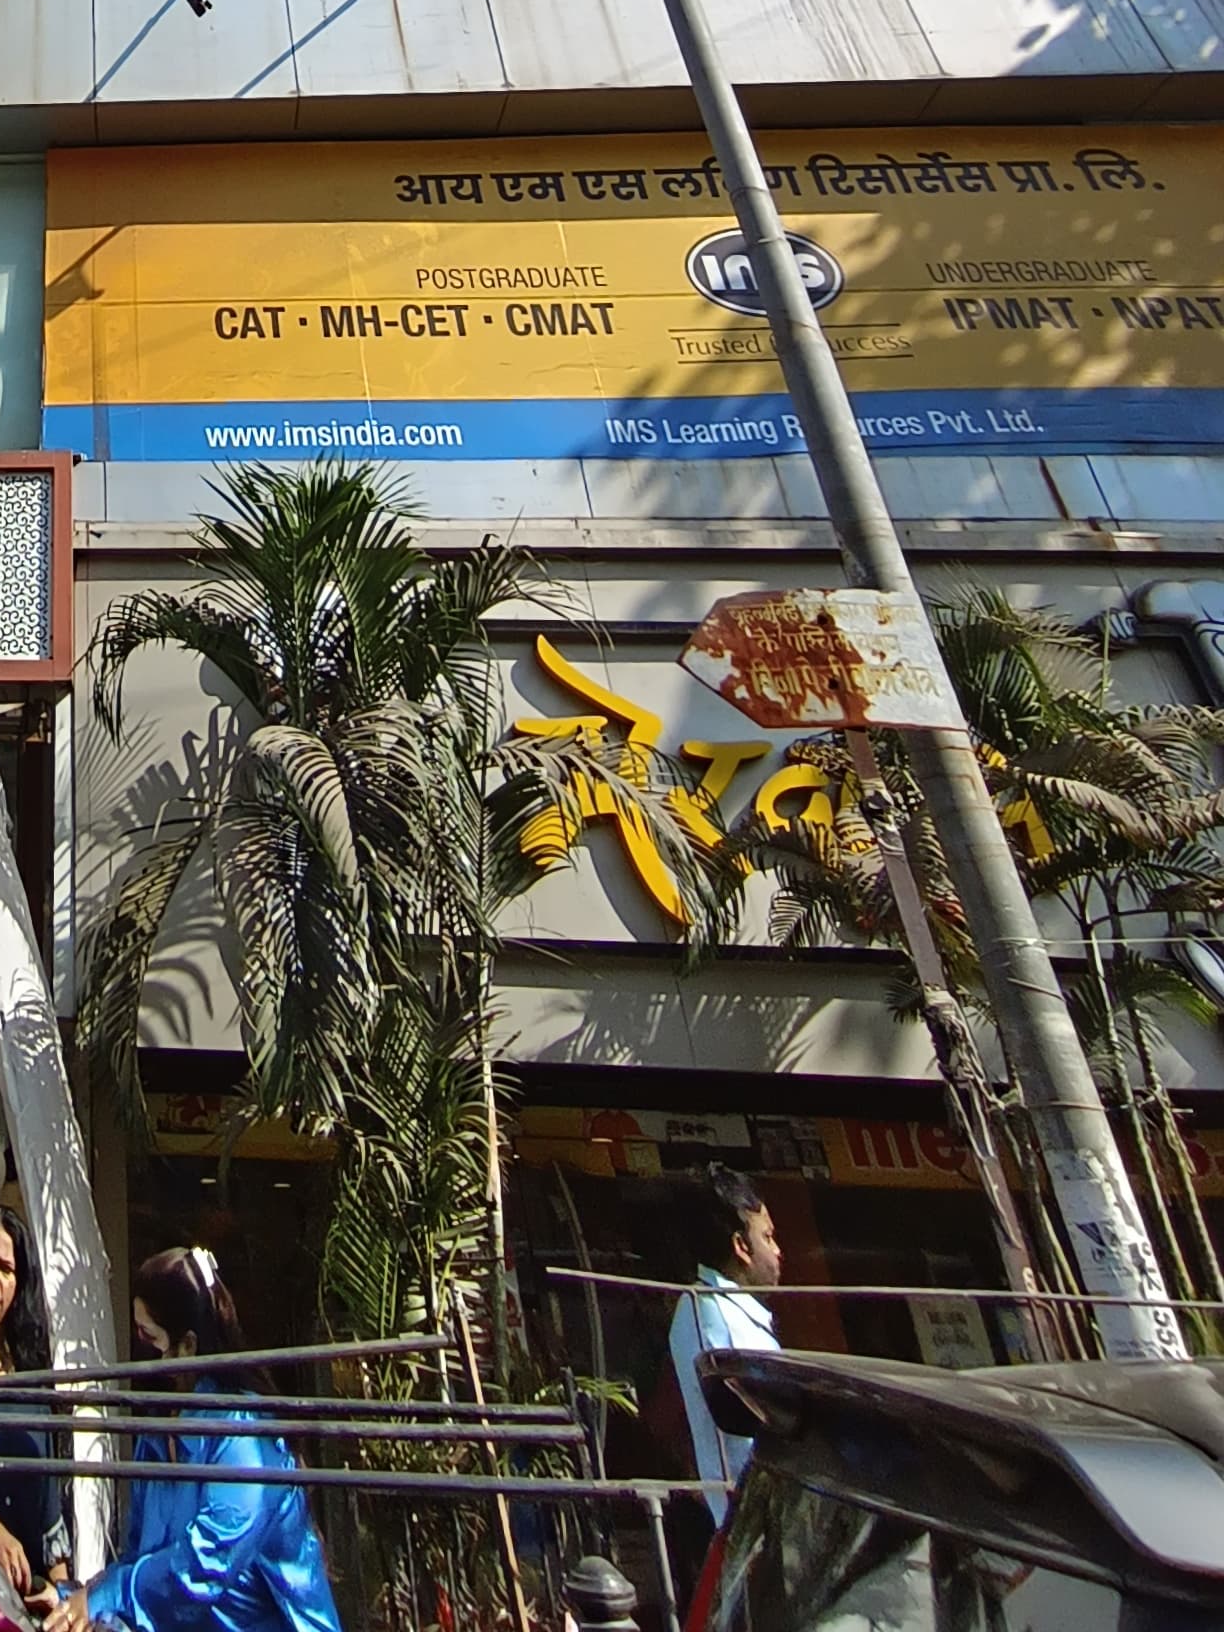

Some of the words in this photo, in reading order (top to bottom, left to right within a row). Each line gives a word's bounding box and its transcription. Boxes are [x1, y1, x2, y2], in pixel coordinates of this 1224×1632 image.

[393, 171, 482, 206] आय
[493, 170, 566, 203] एम
[577, 167, 648, 202] एस
[416, 266, 608, 290] POSTGRADUATE
[926, 259, 1158, 285] UNDERGRADUATE
[214, 304, 285, 340] CAT
[321, 303, 469, 339] MH-CET
[505, 302, 615, 337] CMAT
[944, 295, 1080, 331] IPMAT
[671, 334, 761, 356] Trusted
[828, 334, 912, 354] uccess
[205, 418, 463, 449] www.imsindia.com
[605, 417, 655, 445] IMS
[665, 413, 777, 445] Learning
[926, 408, 984, 435] Pvt.
[992, 408, 1045, 434] Ltd.
